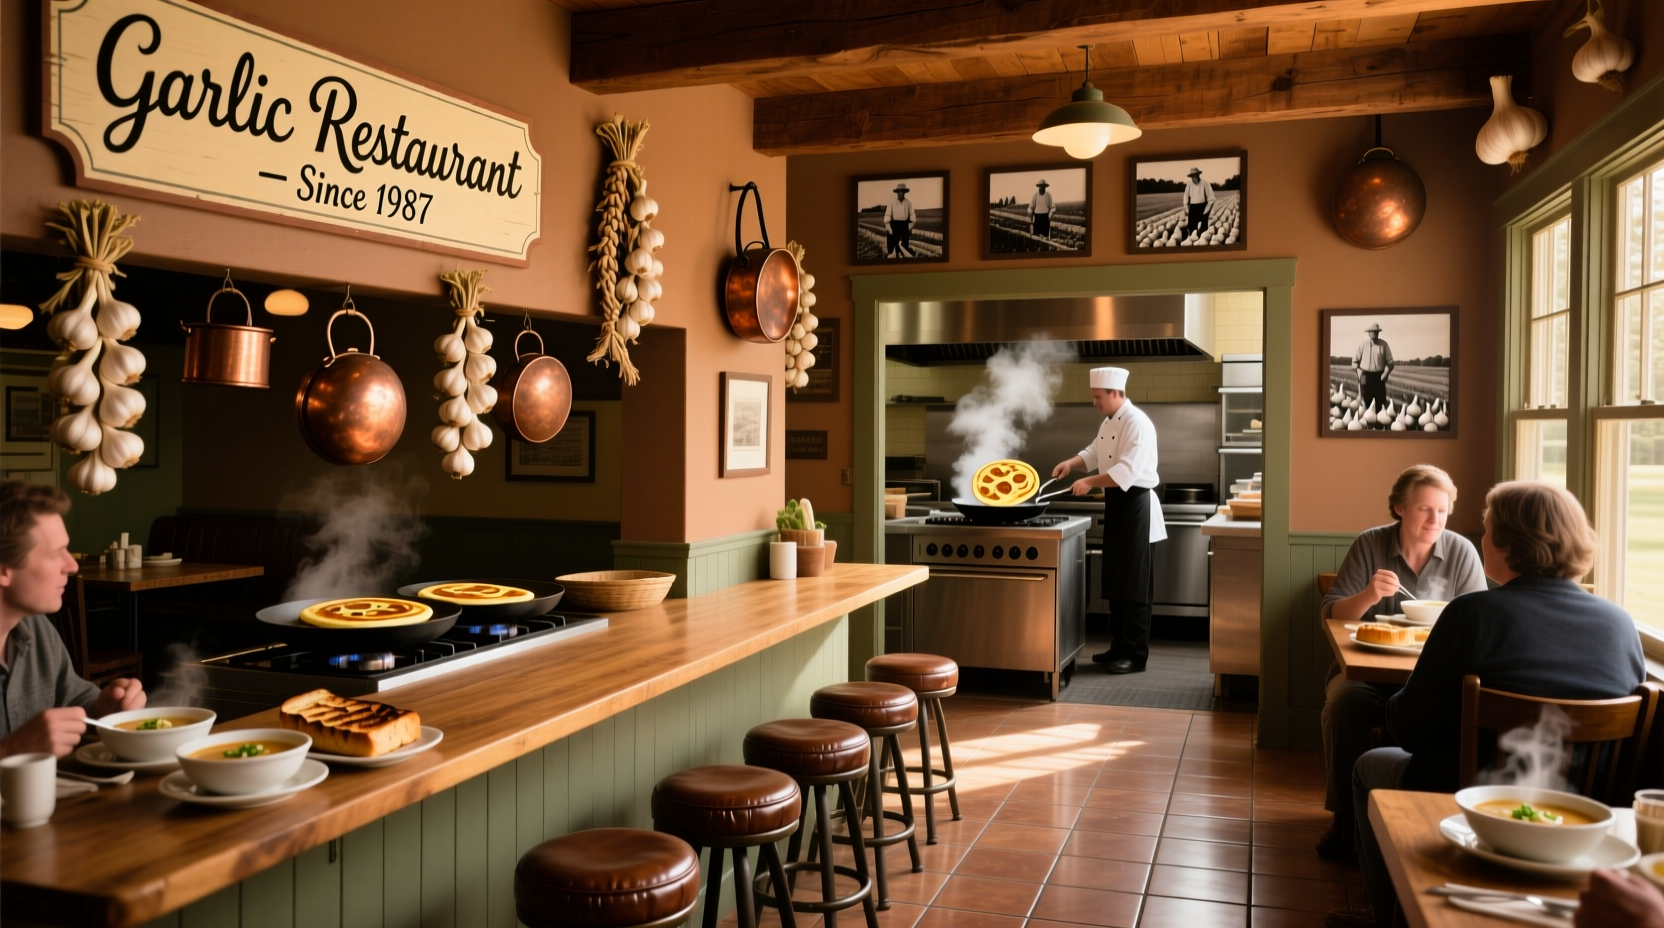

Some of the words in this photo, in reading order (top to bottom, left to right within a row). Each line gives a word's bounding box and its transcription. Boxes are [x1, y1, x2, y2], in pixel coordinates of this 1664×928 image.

[96, 13, 295, 153] Garlic
[308, 75, 523, 200] Restaurant
[296, 164, 367, 211] Since
[376, 183, 434, 225] 1987
